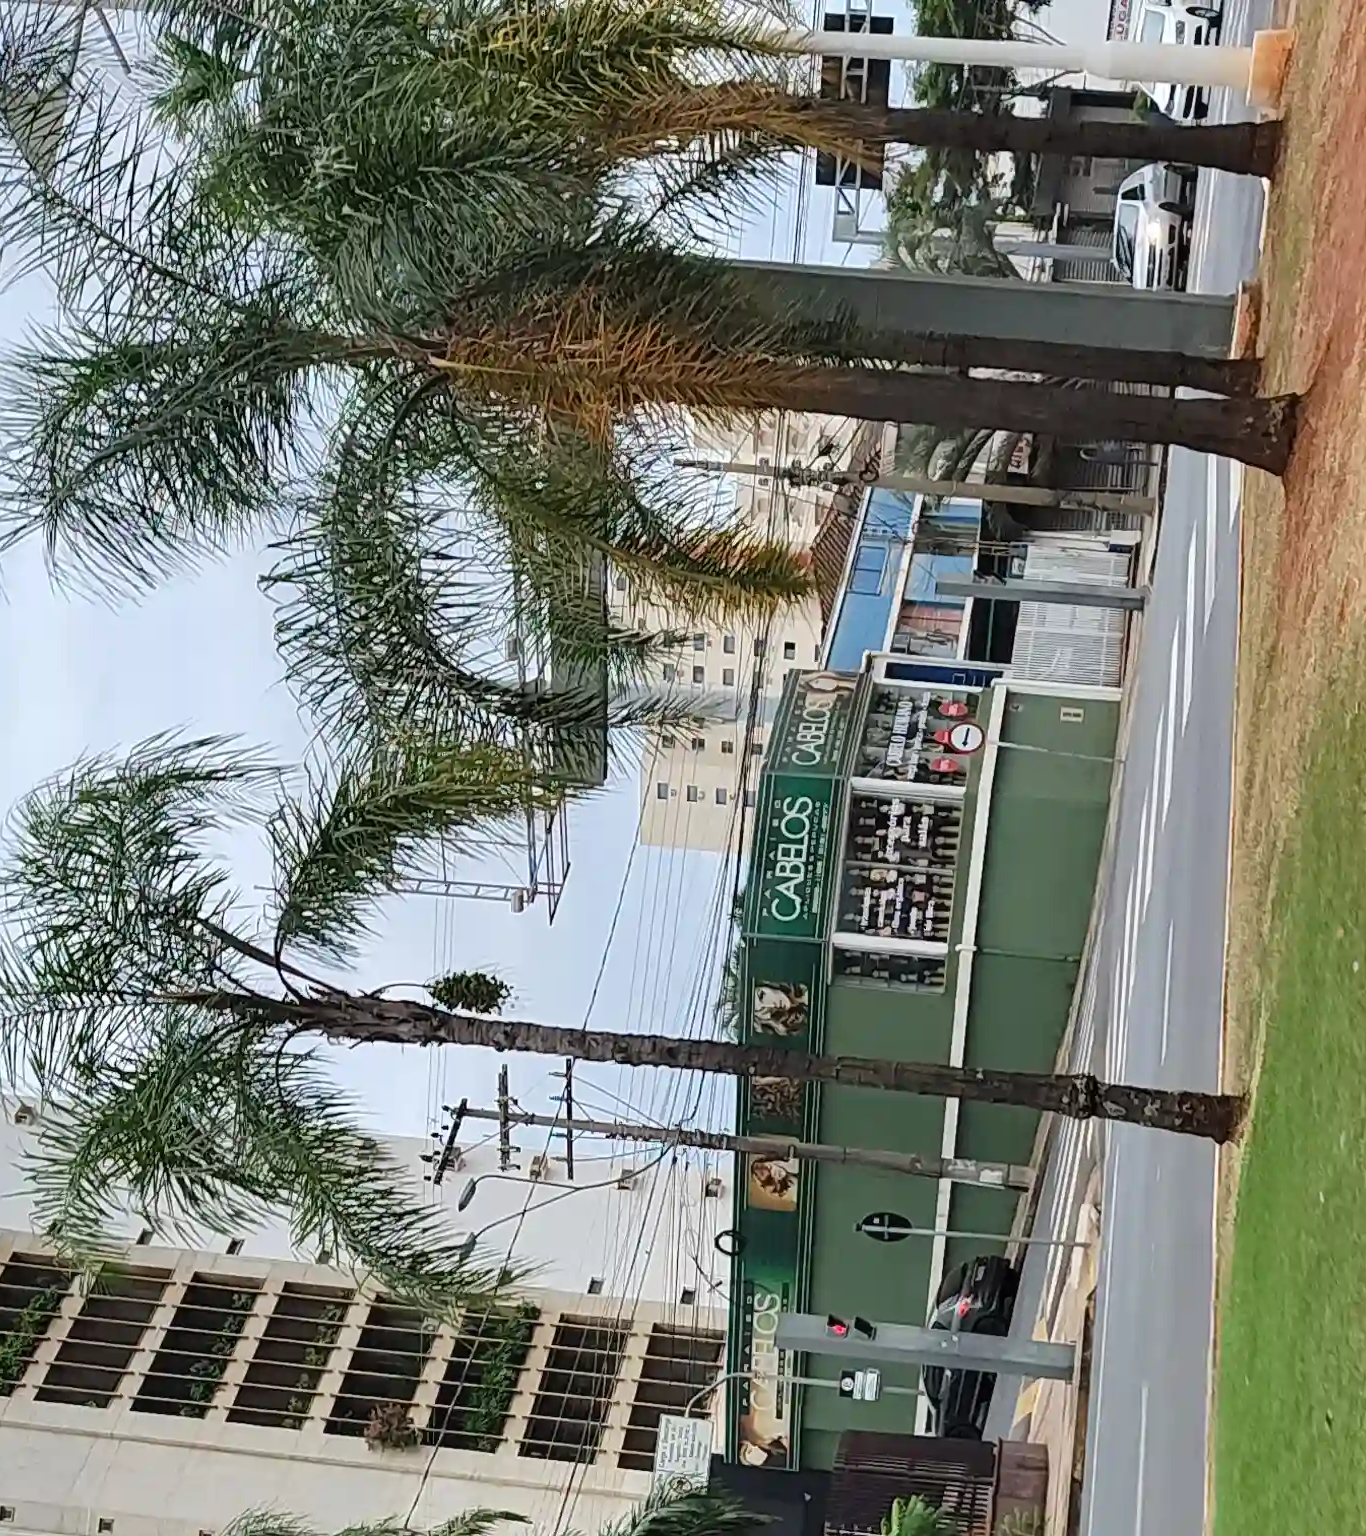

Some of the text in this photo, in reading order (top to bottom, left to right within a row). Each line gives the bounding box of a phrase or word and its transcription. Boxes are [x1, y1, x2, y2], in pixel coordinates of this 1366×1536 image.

[791, 700, 833, 765] CABELOS
[892, 701, 913, 734] HUMANO
[810, 800, 821, 853] PERUCAS
[771, 796, 813, 921] CABELOS
